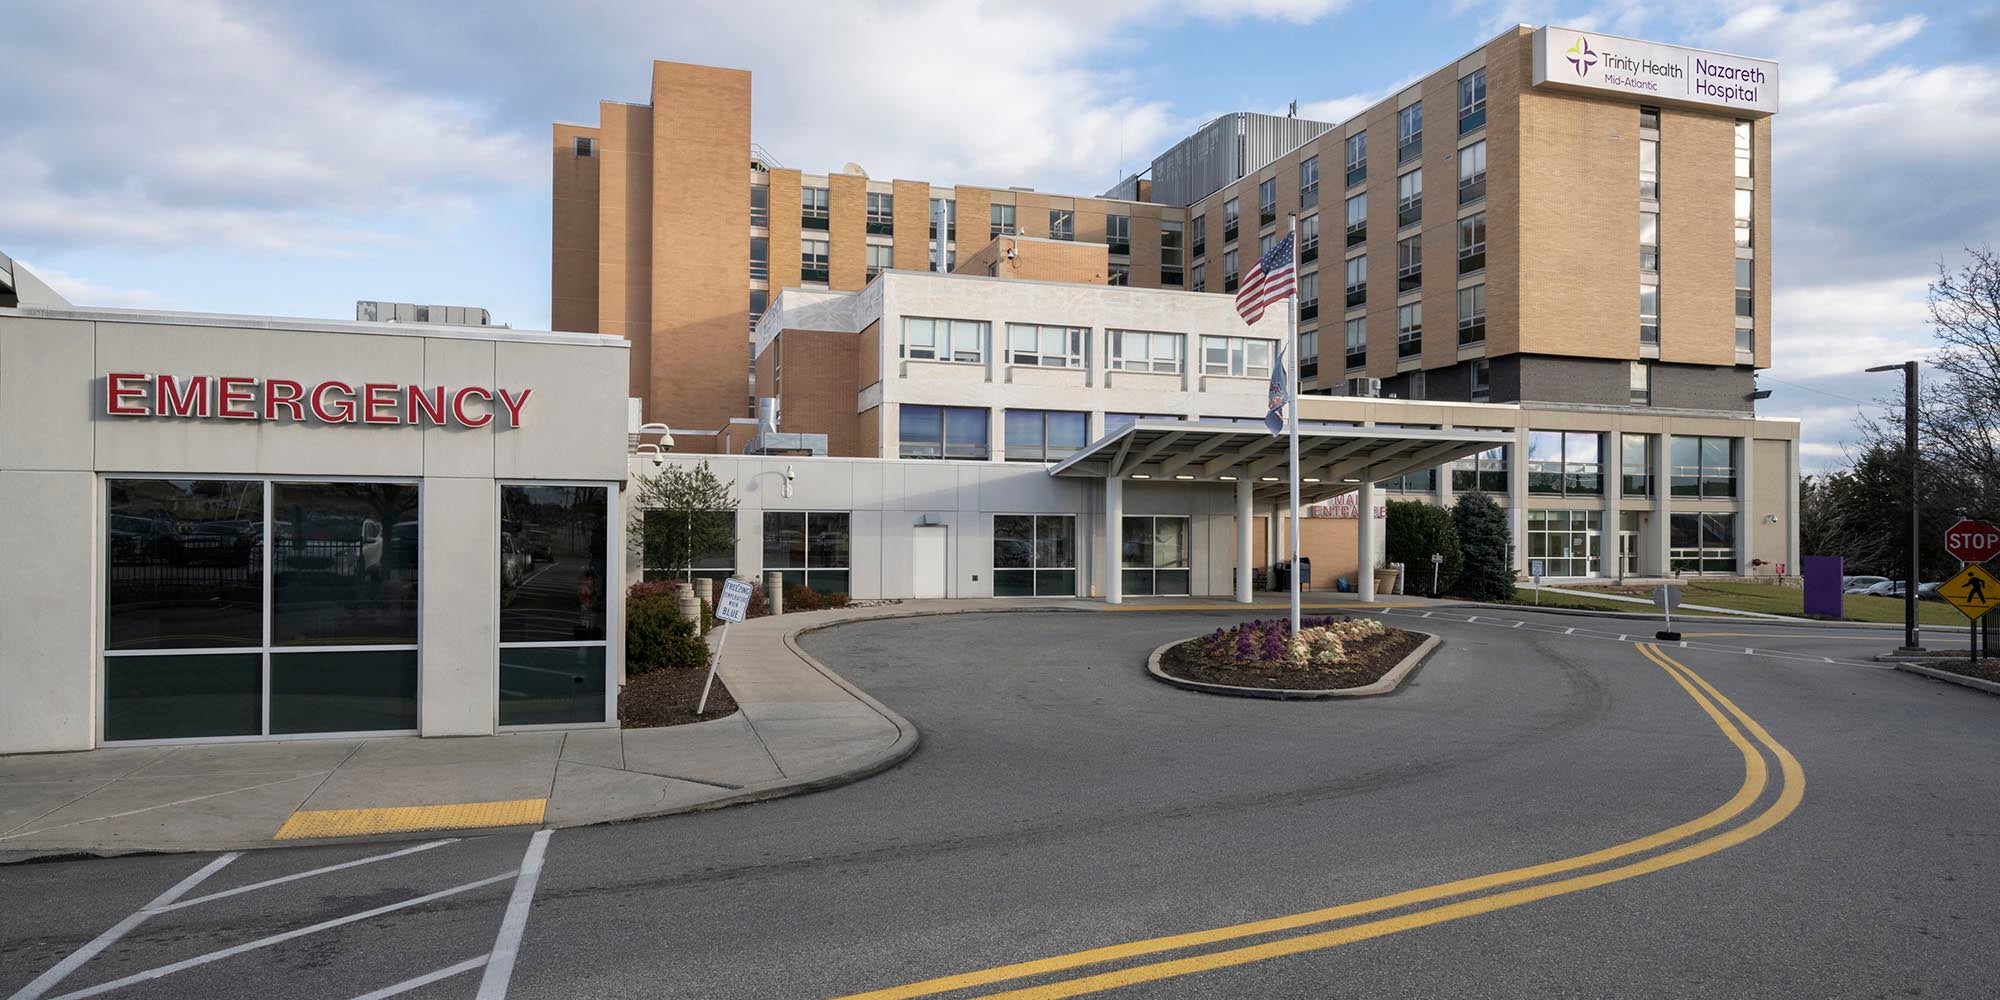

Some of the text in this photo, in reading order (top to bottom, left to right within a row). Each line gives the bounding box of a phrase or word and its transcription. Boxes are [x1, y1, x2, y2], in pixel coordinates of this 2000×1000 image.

[1602, 52, 1683, 79] Trinity Health
[1696, 58, 1765, 84] Nazareth
[1604, 73, 1658, 91] Mid-Atlantic
[1696, 78, 1757, 102] Hospital
[107, 372, 534, 428] EMERGENCY
[1949, 533, 1999, 549] STOP
[726, 581, 751, 595] FREEZING
[722, 606, 740, 618] BLUE
